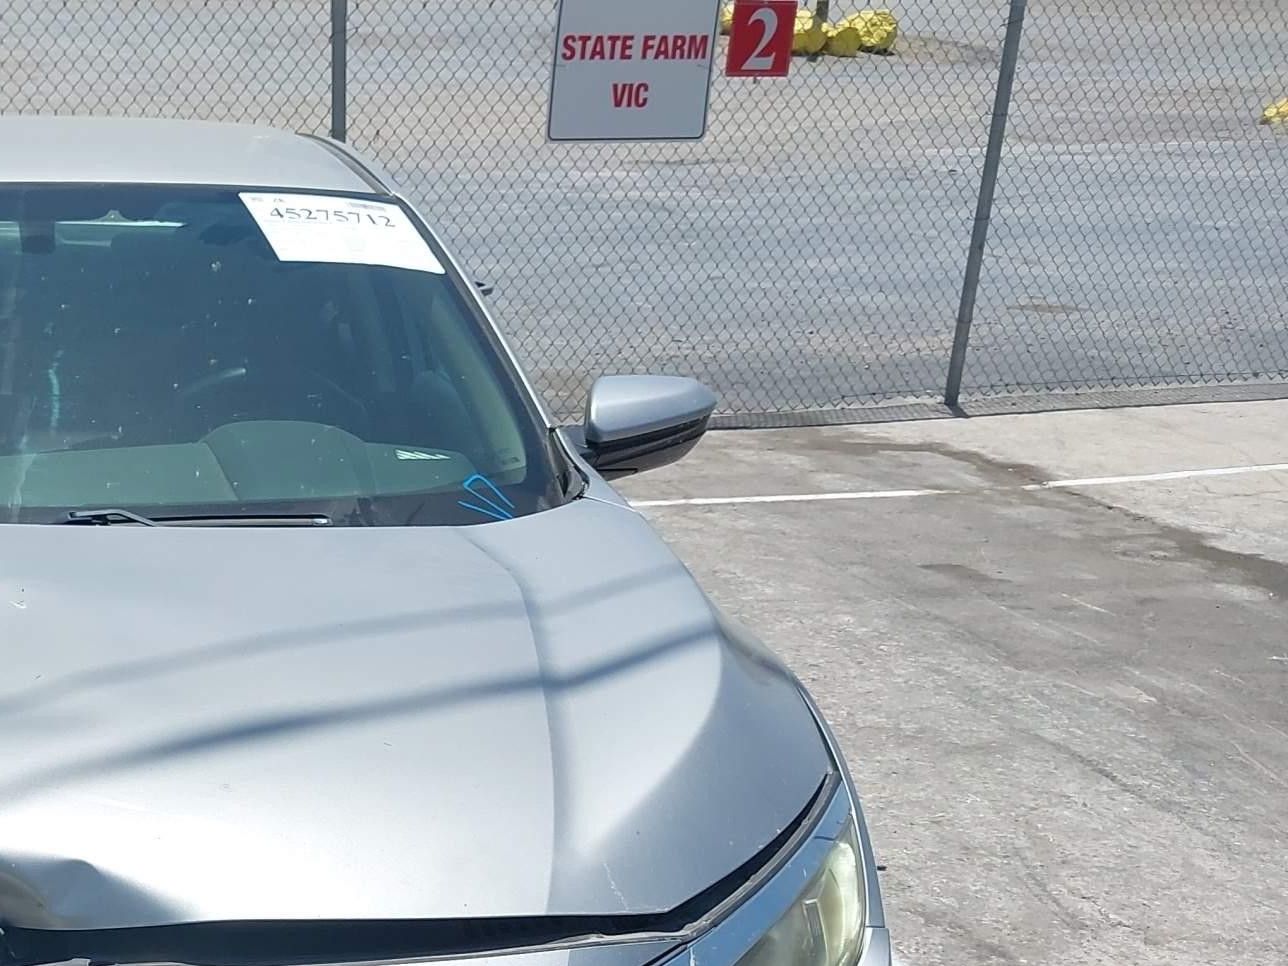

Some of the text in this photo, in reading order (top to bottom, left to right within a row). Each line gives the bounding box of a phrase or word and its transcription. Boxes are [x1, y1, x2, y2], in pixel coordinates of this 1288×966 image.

[560, 33, 709, 61] STATE FARM
[740, 7, 778, 71] 2
[611, 82, 649, 109] VIC
[269, 206, 396, 228] 45275712
